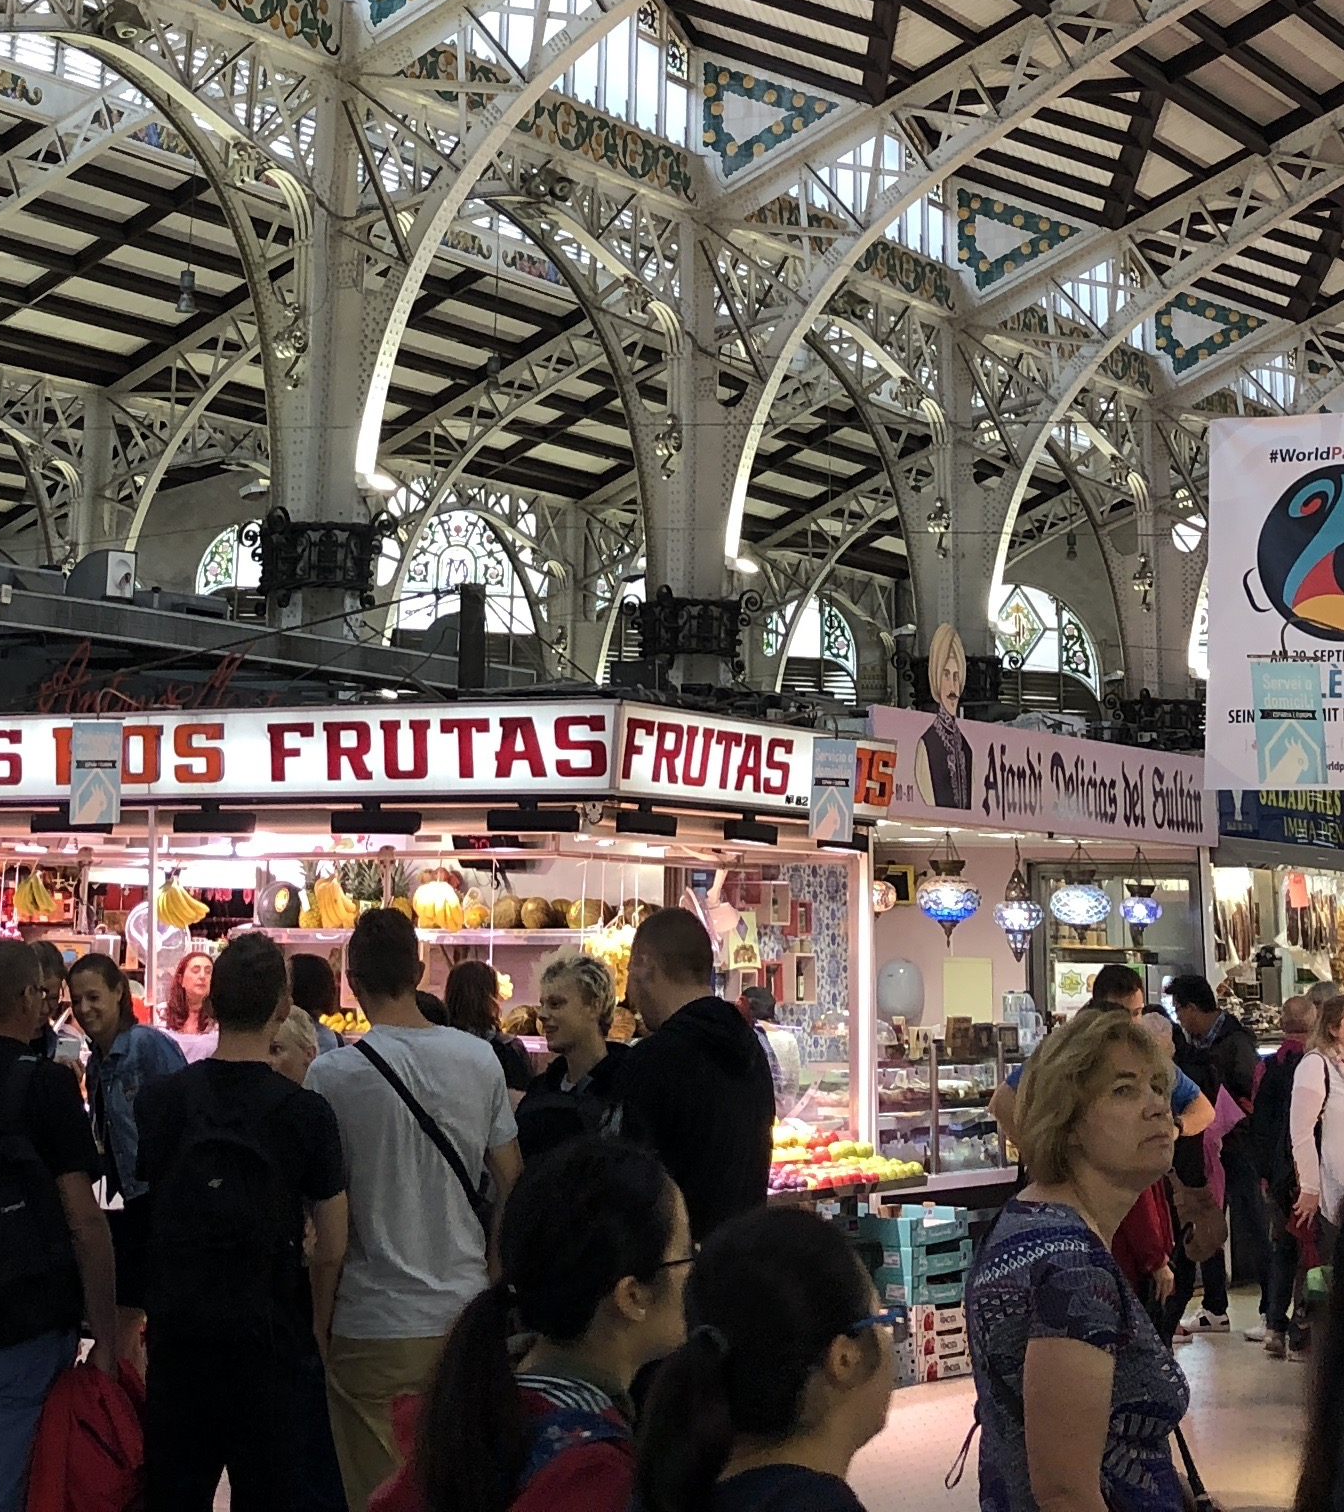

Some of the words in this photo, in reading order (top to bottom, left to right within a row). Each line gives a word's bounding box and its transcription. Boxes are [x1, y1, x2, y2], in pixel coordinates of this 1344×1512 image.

[1270, 649, 1289, 663] AM
[266, 714, 608, 783] FRUTAS
[621, 717, 795, 796] FRUTAS
[982, 742, 1043, 821] Afandi
[1050, 751, 1117, 825] Delicias
[1122, 760, 1146, 829] del
[1152, 766, 1204, 834] Sultán
[1284, 815, 1317, 841] IMMA
